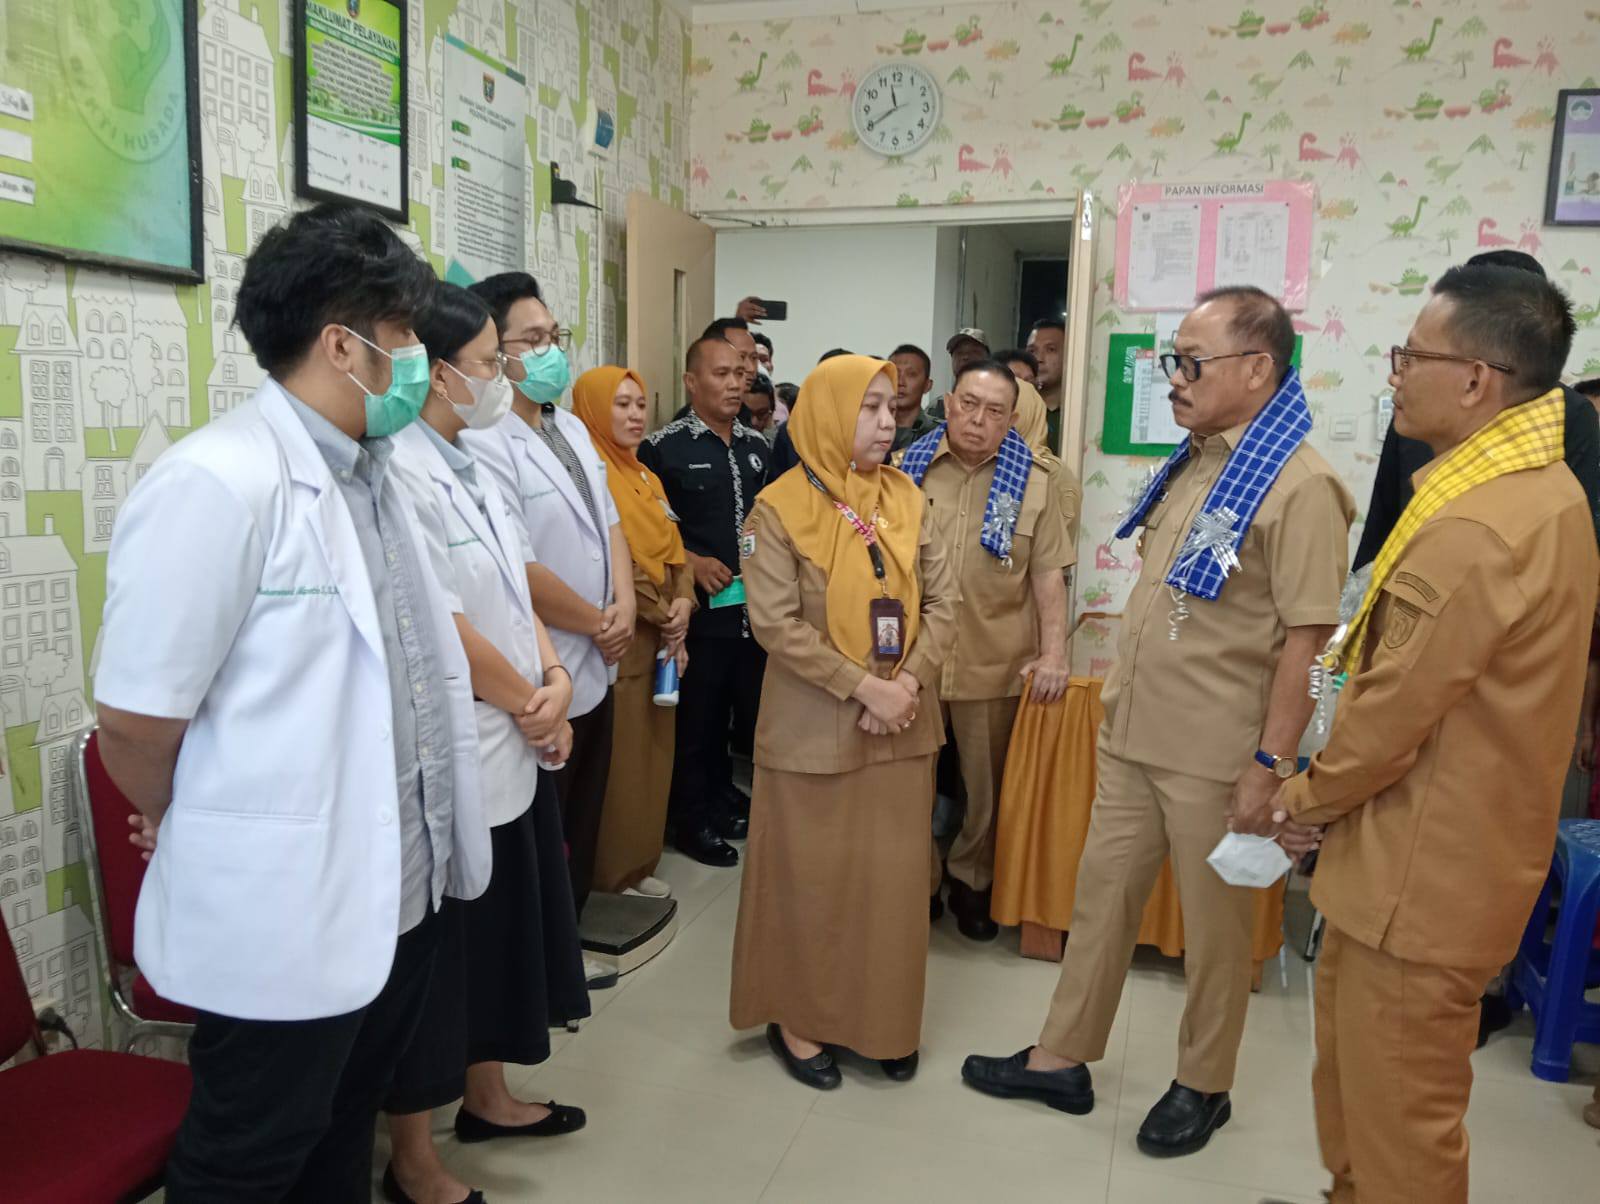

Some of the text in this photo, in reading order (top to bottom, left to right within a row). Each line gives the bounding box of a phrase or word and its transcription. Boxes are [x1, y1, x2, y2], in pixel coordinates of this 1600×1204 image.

[353, 21, 399, 52] PELAYANAN
[879, 77, 887, 87] 11
[893, 72, 903, 82] 12
[910, 76, 914, 85] 1
[867, 89, 878, 99] 10
[920, 86, 926, 96] 2
[863, 105, 870, 115] 9
[923, 103, 930, 113] 3
[123, 92, 180, 152] HUSADA
[867, 120, 874, 131] 8
[917, 118, 924, 128] 4
[879, 132, 886, 142] 7
[892, 136, 899, 145] 6
[907, 131, 914, 141] 5
[1165, 183, 1264, 196] PAPAN INFORMASI
